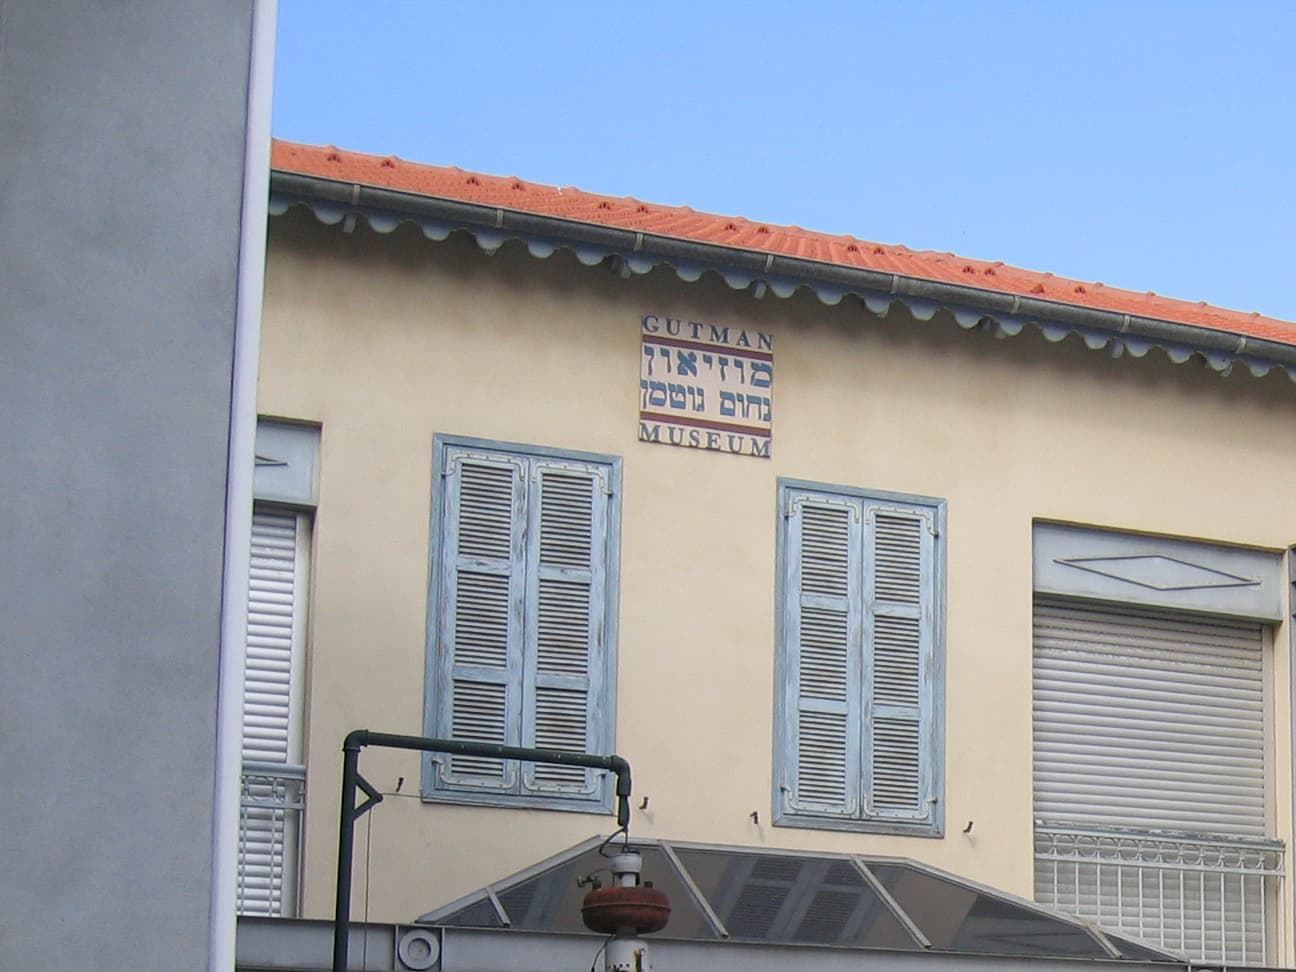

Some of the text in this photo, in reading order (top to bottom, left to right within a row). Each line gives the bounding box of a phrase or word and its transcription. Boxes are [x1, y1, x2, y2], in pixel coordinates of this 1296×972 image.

[643, 314, 774, 350] GUTMAN
[644, 345, 773, 388] מוזיאון
[640, 379, 772, 422] נחום גוטמן
[640, 422, 771, 457] MUSEUM
